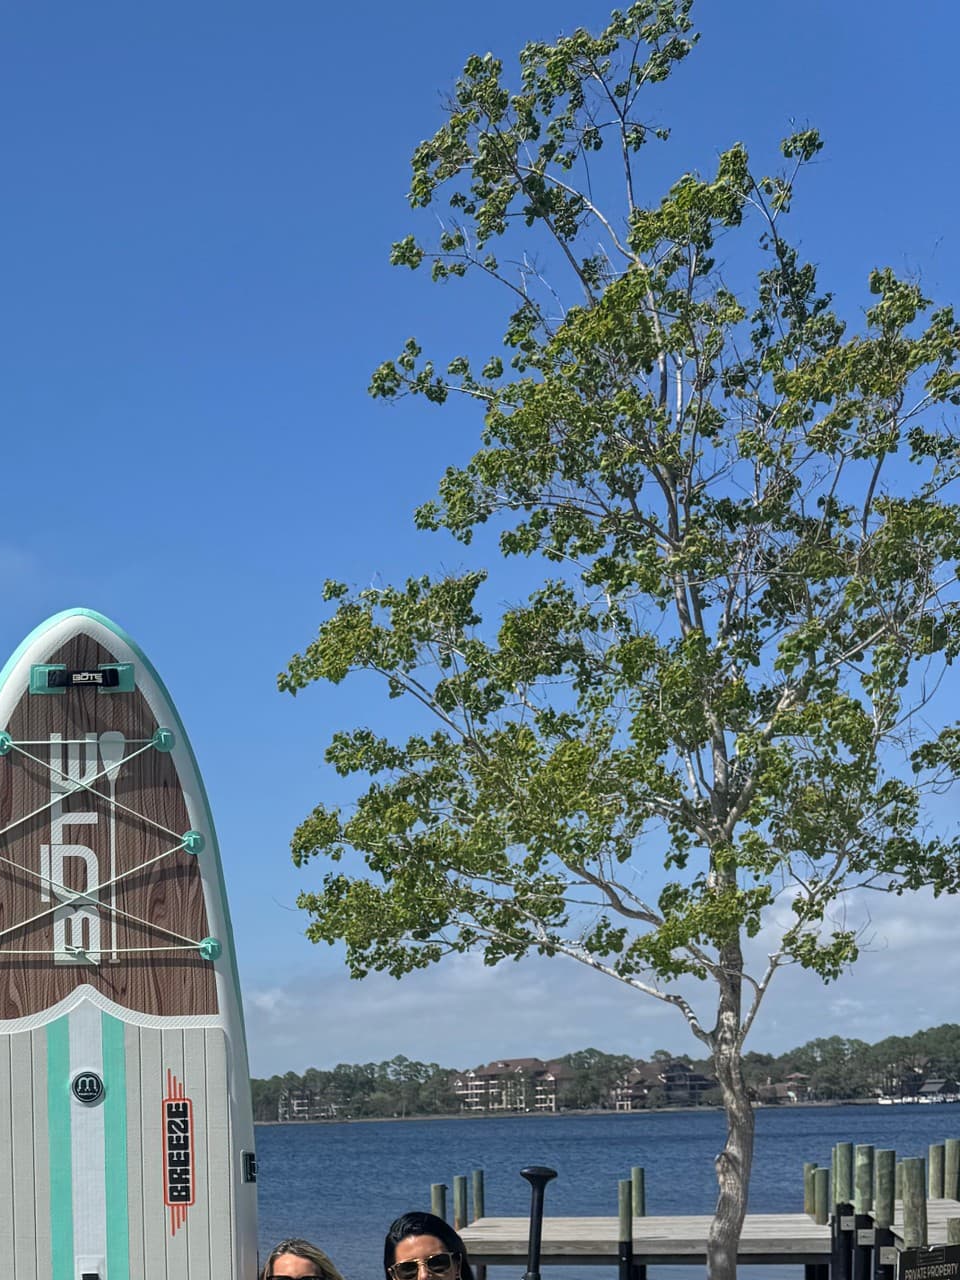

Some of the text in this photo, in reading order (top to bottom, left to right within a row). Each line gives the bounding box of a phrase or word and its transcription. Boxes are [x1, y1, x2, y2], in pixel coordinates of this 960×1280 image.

[167, 1102, 191, 1202] BREEZE
[905, 1263, 958, 1280] PRIVATE PROPERTY
